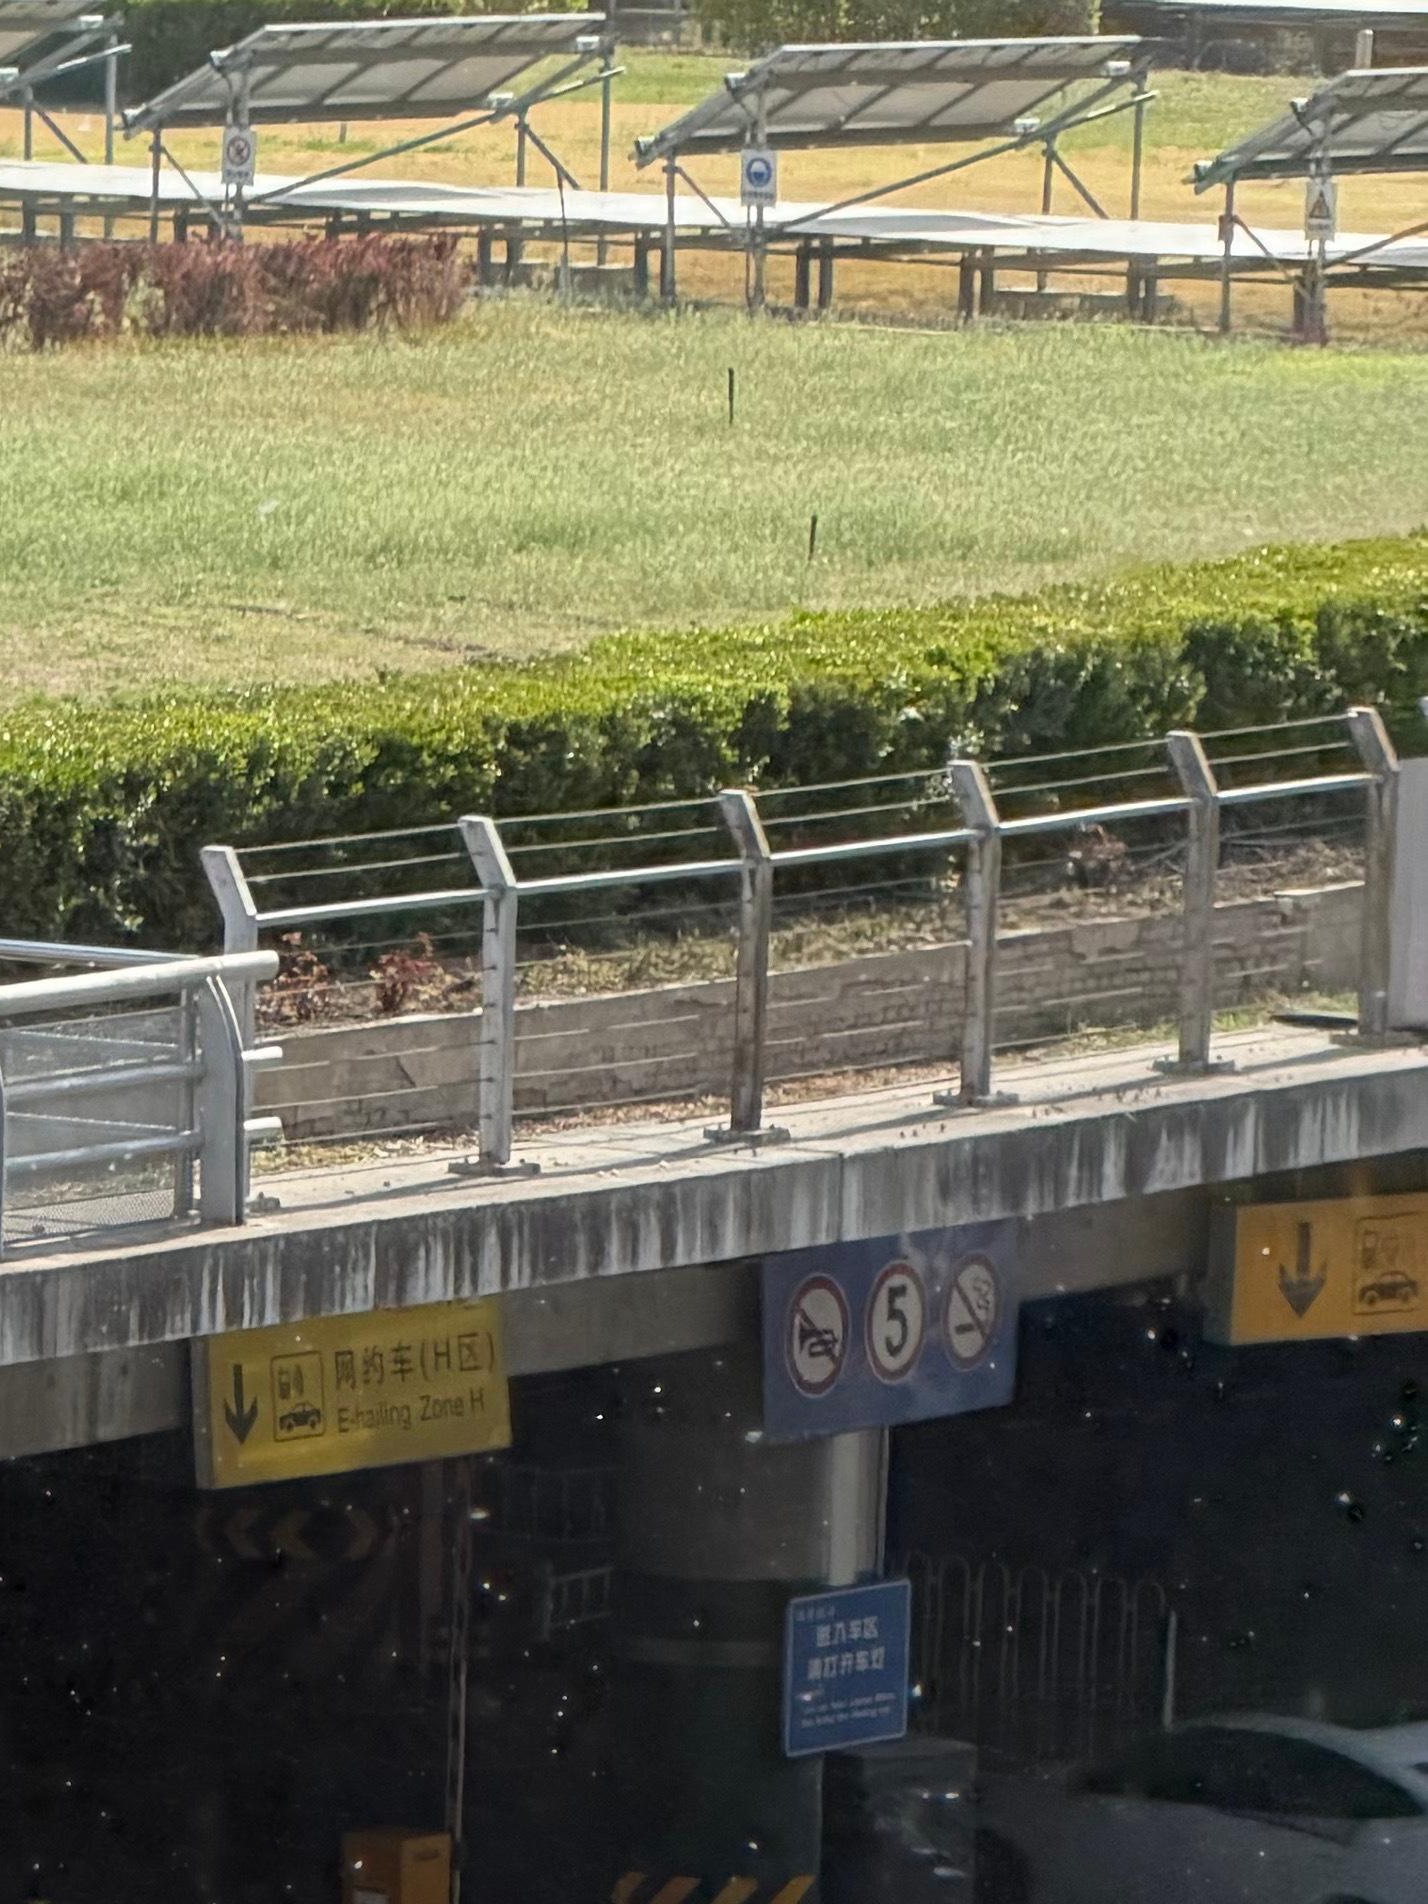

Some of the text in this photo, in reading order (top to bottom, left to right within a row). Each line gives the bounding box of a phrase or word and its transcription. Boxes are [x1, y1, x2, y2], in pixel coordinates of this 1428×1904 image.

[885, 1284, 908, 1357] 5
[419, 1394, 465, 1421] Zone
[470, 1387, 485, 1412] H
